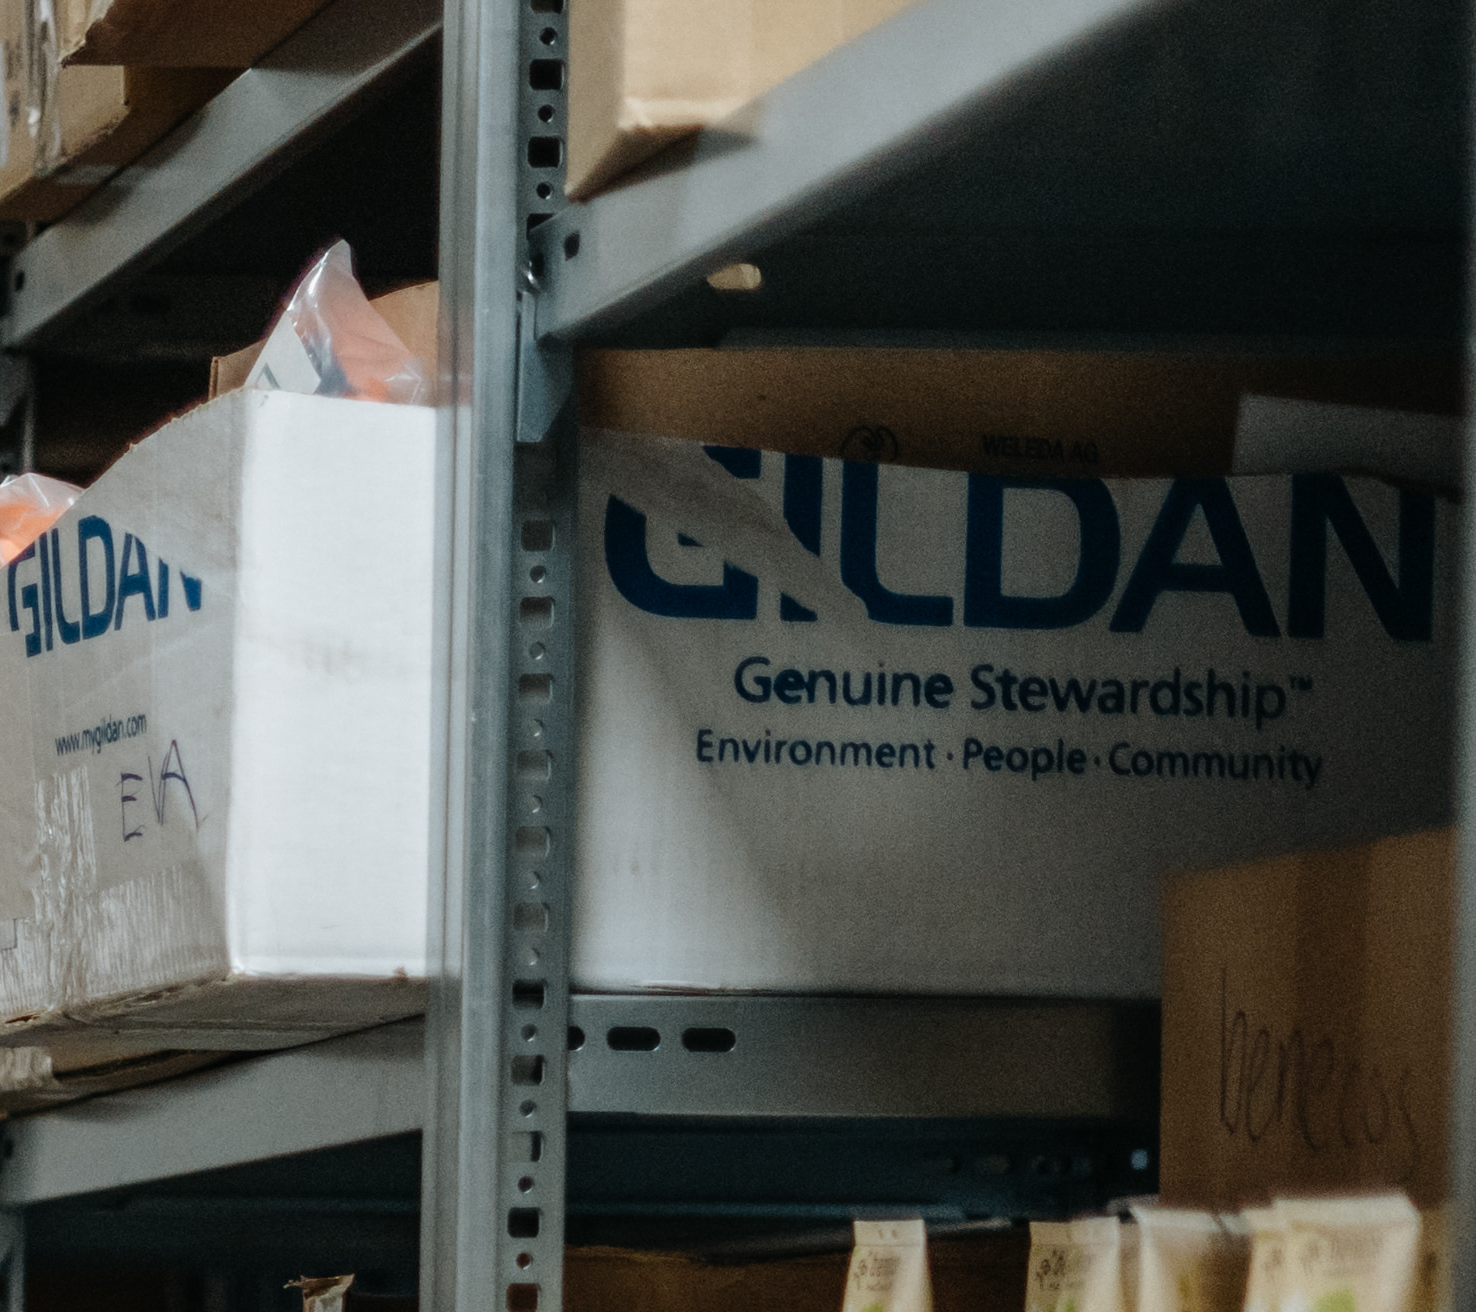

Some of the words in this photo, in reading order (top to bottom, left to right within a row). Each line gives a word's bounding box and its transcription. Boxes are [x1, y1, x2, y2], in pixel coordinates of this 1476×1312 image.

[981, 434, 1065, 461] WELEDA
[1070, 439, 1100, 464] AG
[734, 655, 954, 709] Genuine
[54, 713, 148, 757] www.mygildan.com
[695, 728, 936, 768] Environment
[962, 737, 1087, 780] People
[1107, 741, 1323, 791] Community
[116, 738, 199, 843] EVA
